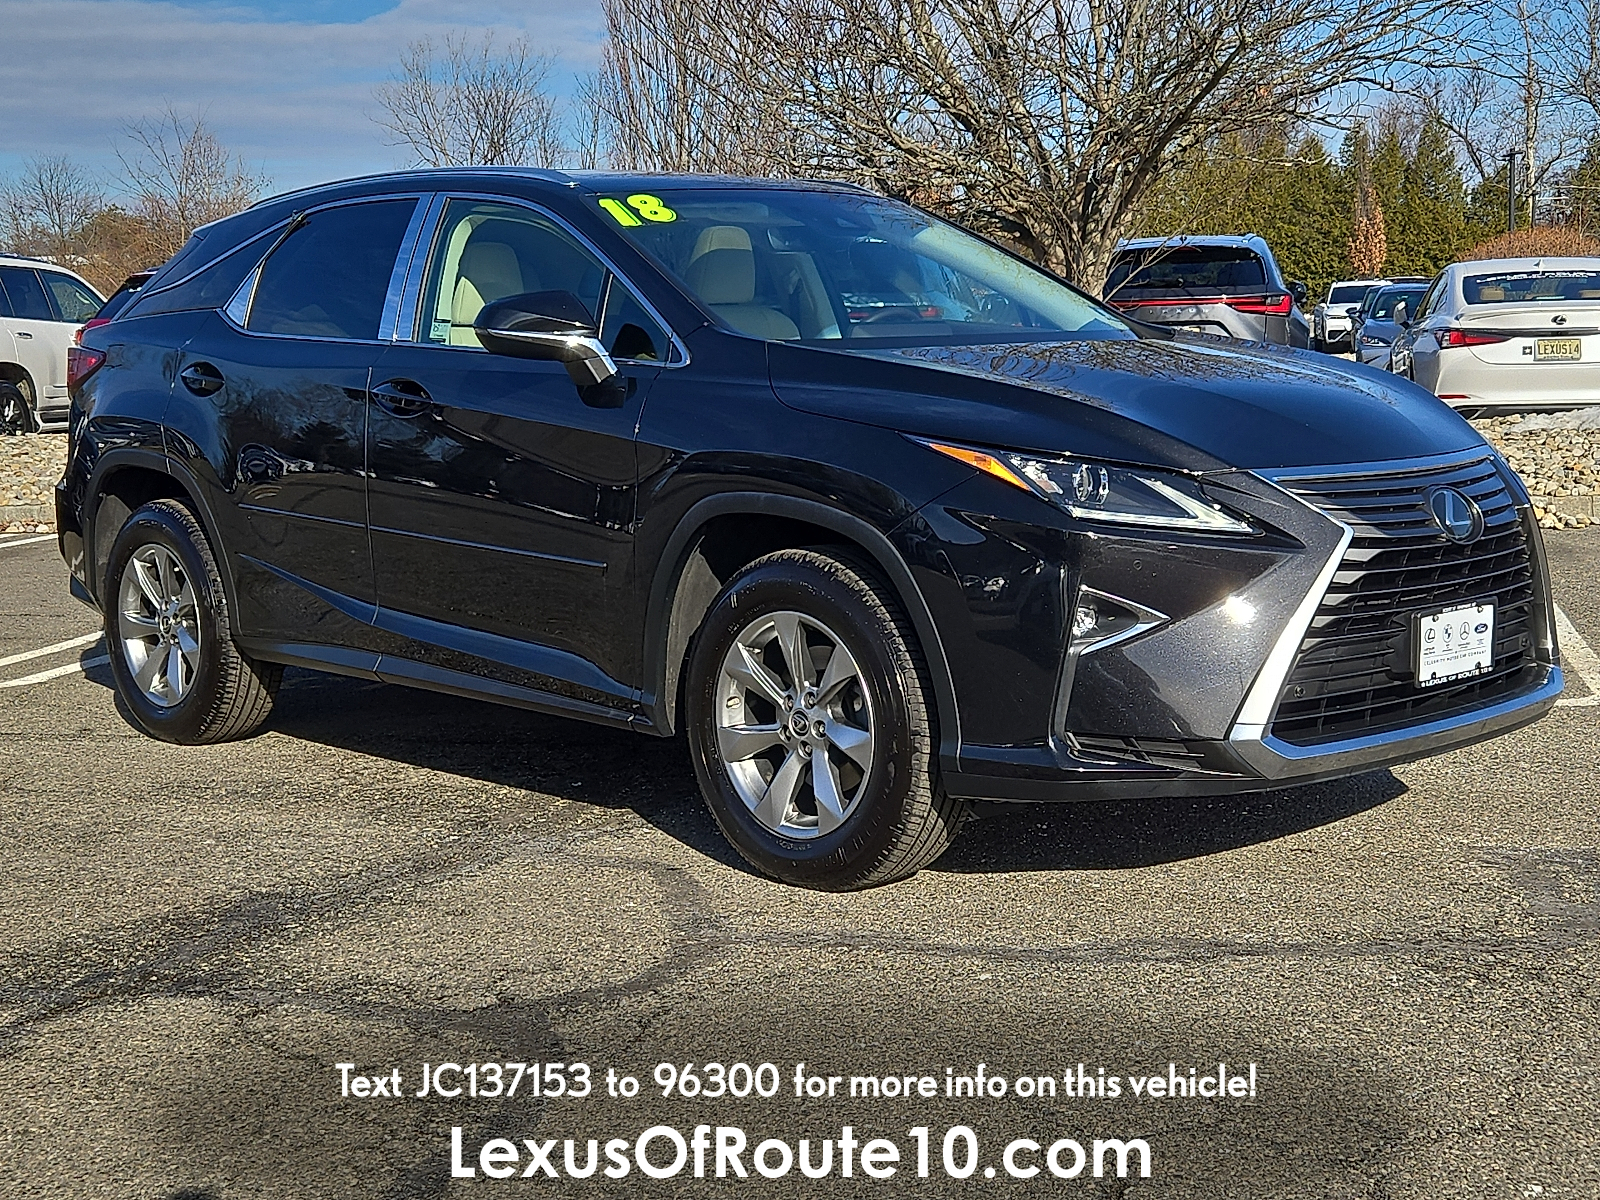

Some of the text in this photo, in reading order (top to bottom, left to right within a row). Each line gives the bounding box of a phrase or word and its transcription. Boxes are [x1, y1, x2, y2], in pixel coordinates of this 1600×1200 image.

[598, 193, 677, 227] 18
[1425, 676, 1448, 687] LEXUS
[1457, 668, 1480, 680] ROUTE
